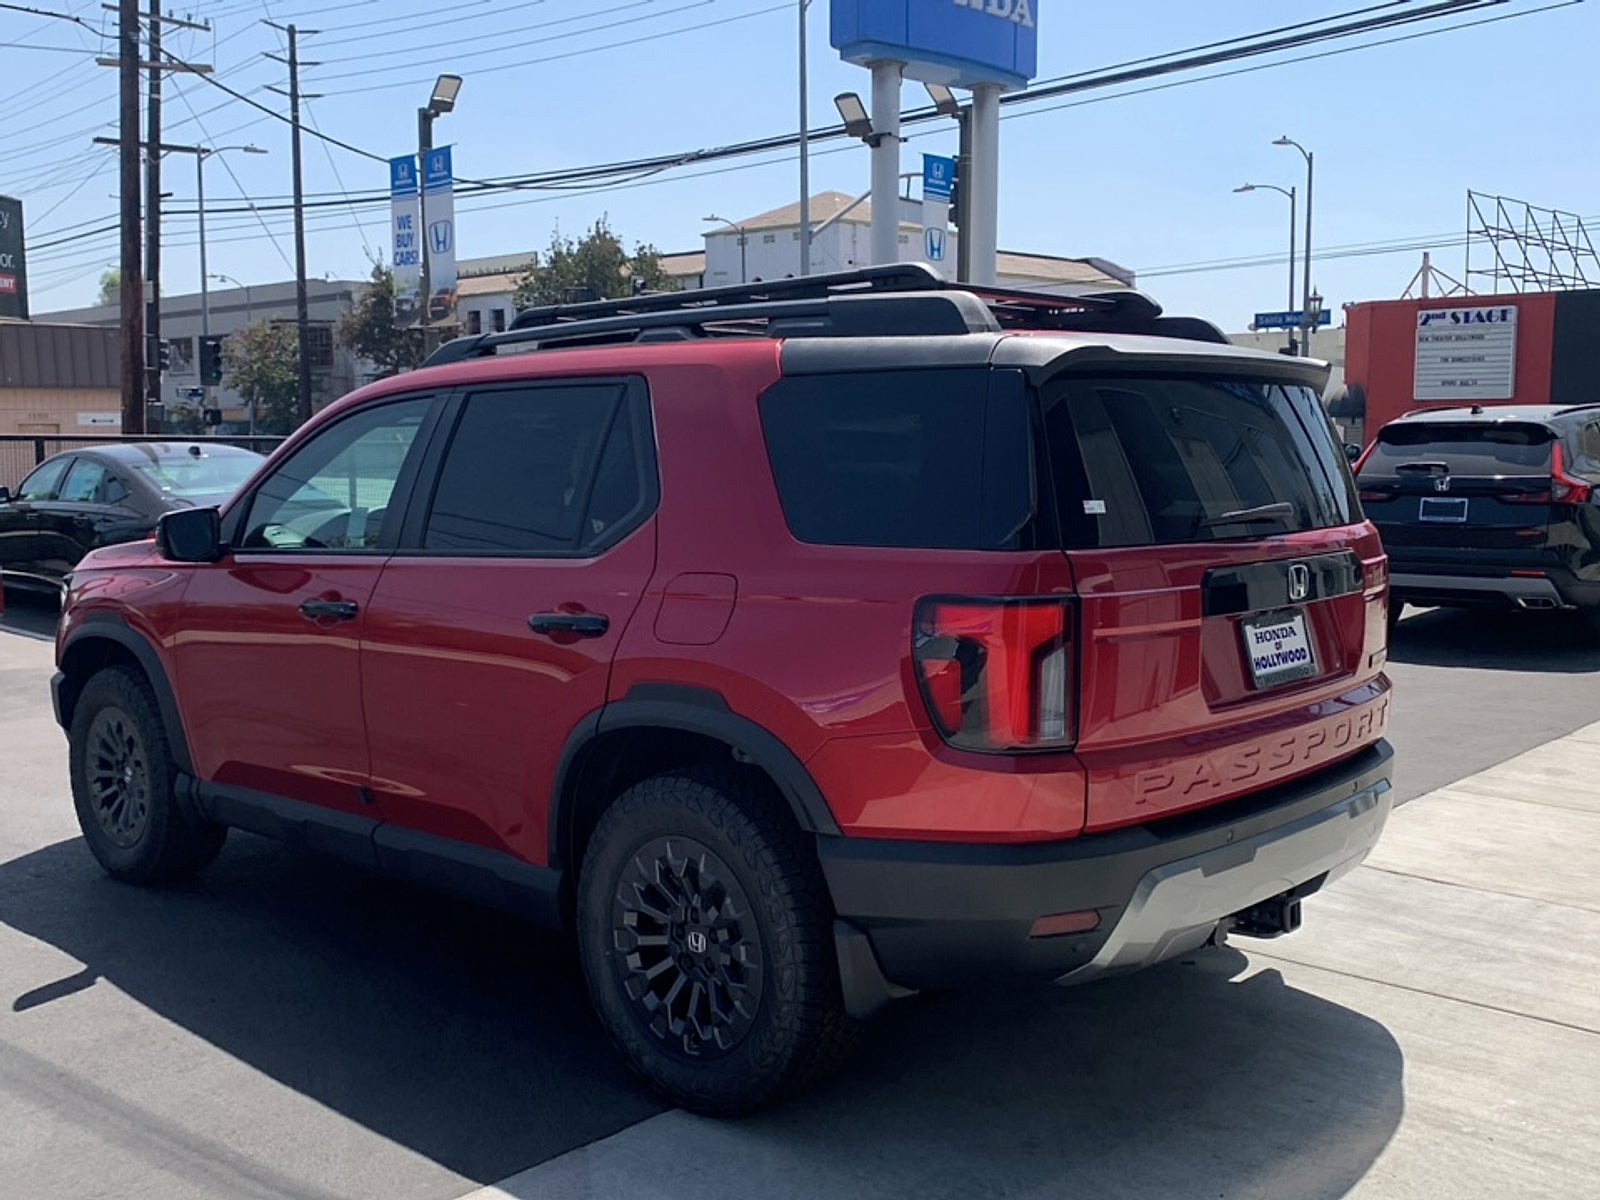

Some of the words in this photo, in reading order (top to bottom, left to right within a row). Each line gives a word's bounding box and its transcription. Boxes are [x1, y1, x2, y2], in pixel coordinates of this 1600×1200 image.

[396, 213, 412, 230] WE
[395, 232, 414, 248] BUY
[1419, 312, 1446, 326] 2nd
[1449, 308, 1512, 325] STAGE
[1254, 626, 1297, 644] HONDA
[1253, 647, 1307, 670] HOLLYWOOD
[1135, 699, 1389, 805] PASSPORT
